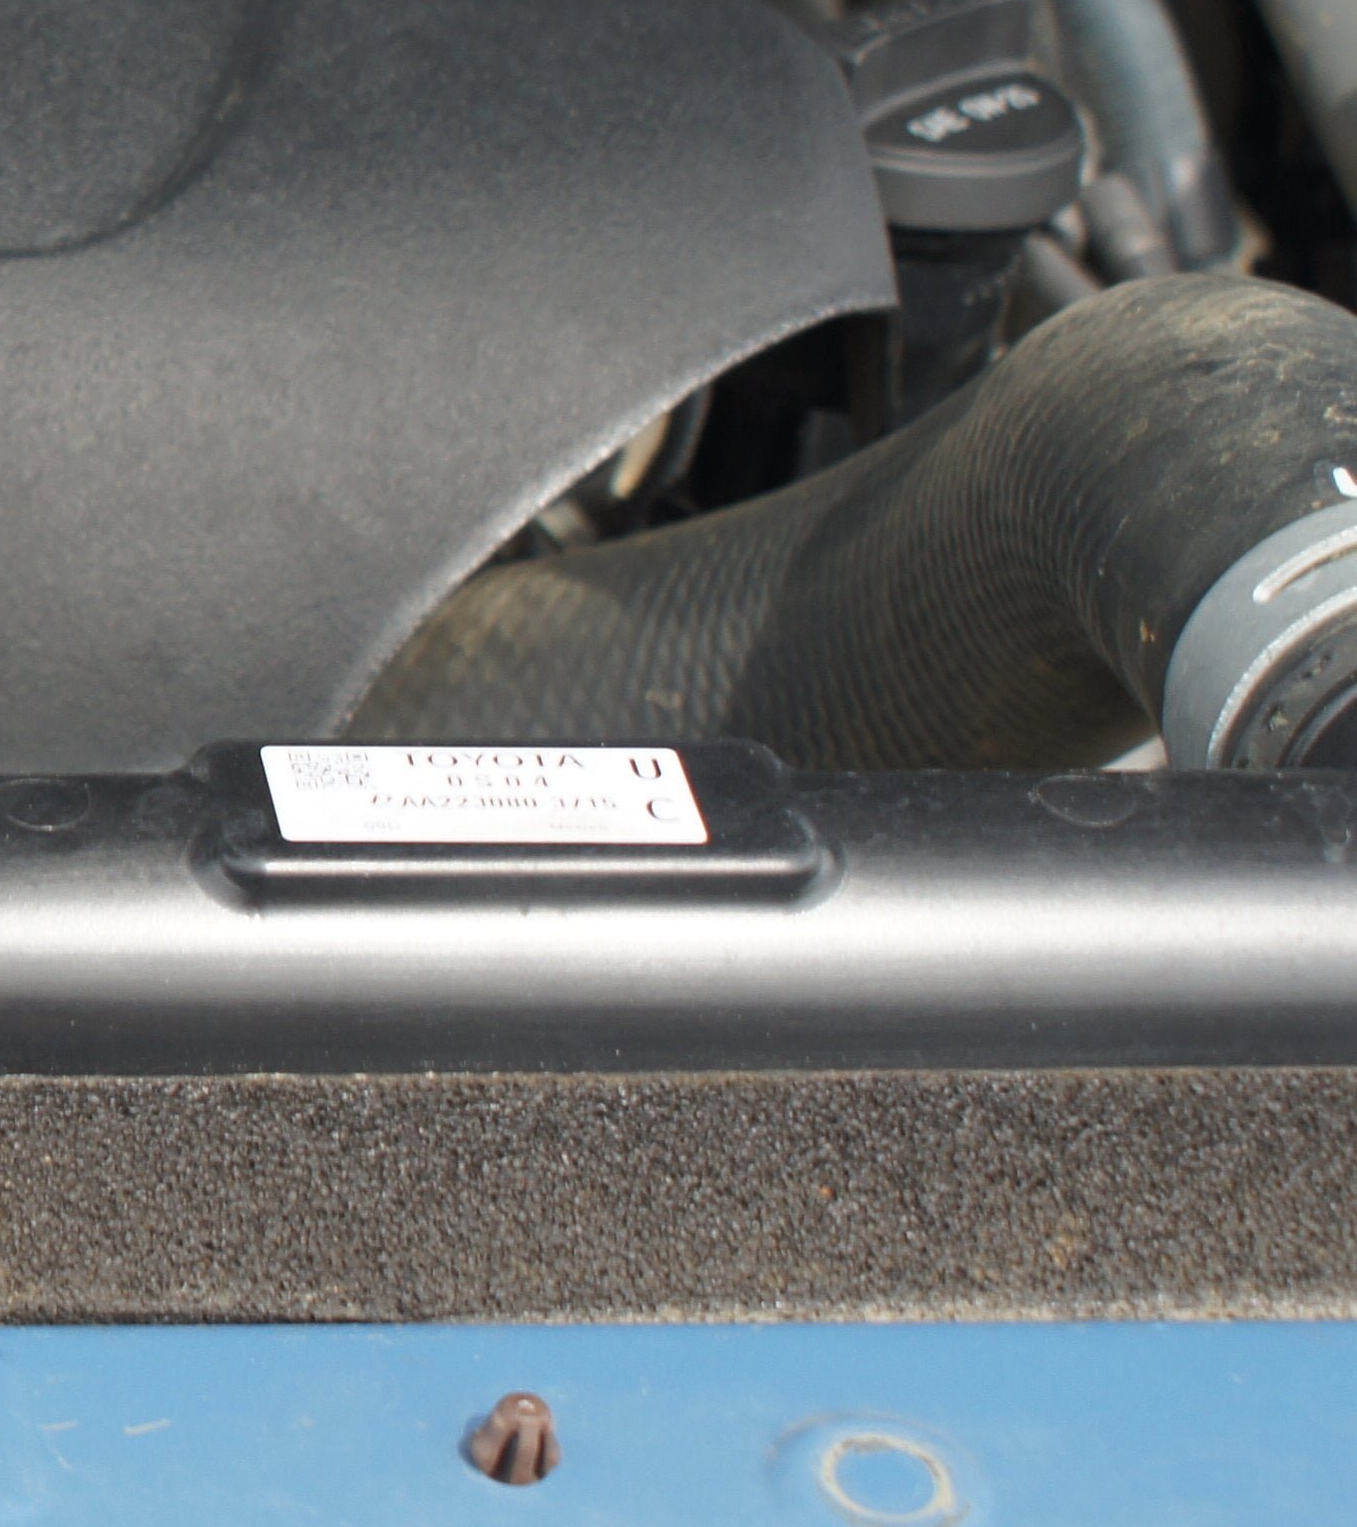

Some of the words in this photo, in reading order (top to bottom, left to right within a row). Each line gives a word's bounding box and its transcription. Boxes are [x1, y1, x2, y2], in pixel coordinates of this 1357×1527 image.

[395, 752, 585, 769] TOYOTA
[628, 756, 664, 781] U
[646, 796, 682, 823] C
